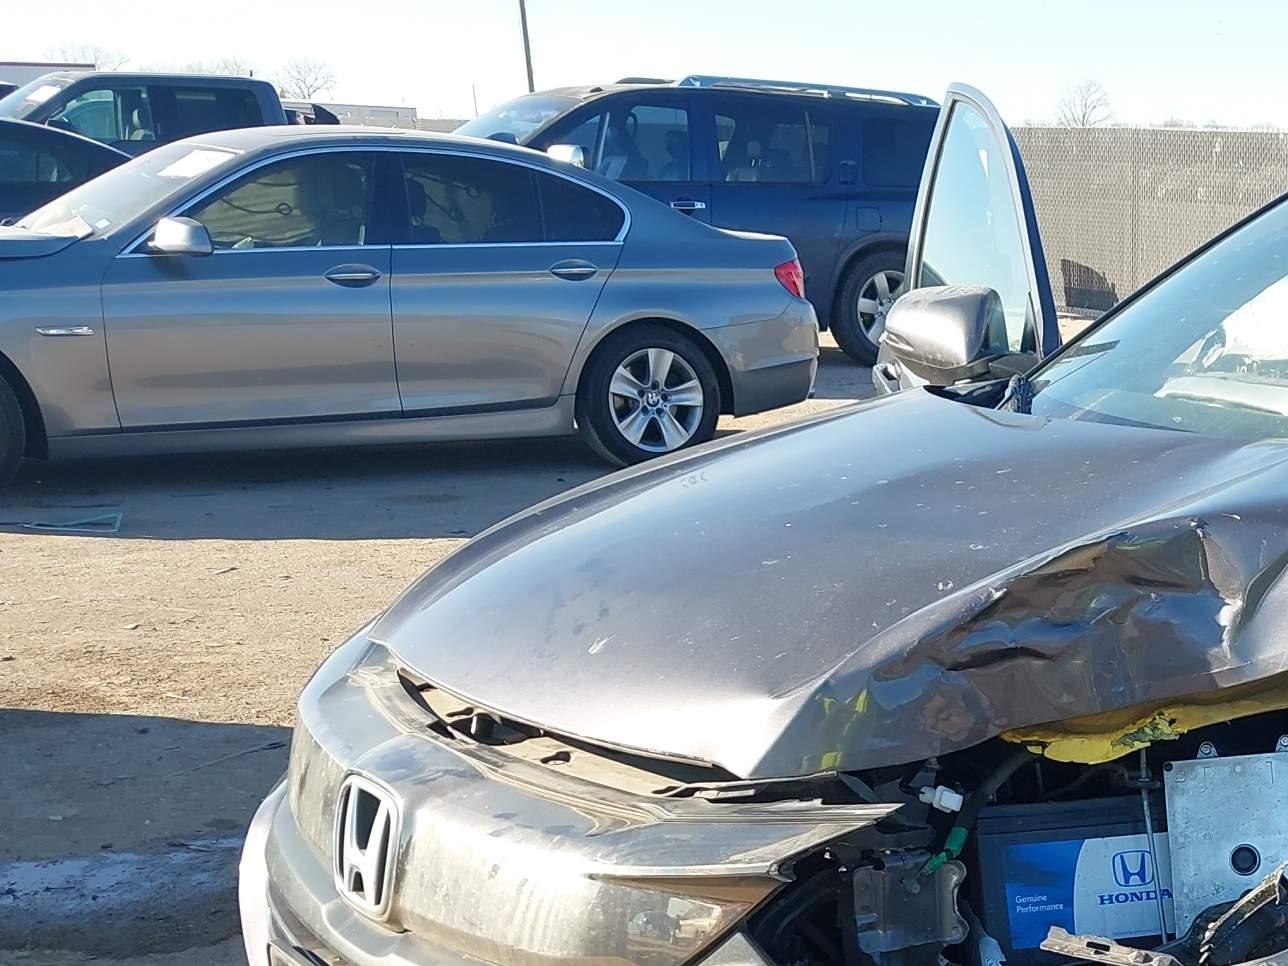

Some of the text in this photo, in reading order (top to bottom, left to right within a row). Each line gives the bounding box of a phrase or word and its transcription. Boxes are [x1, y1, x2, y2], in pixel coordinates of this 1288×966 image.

[1015, 894, 1047, 903] Genuine
[1098, 889, 1173, 905] HONDA
[1016, 903, 1064, 913] Performance
